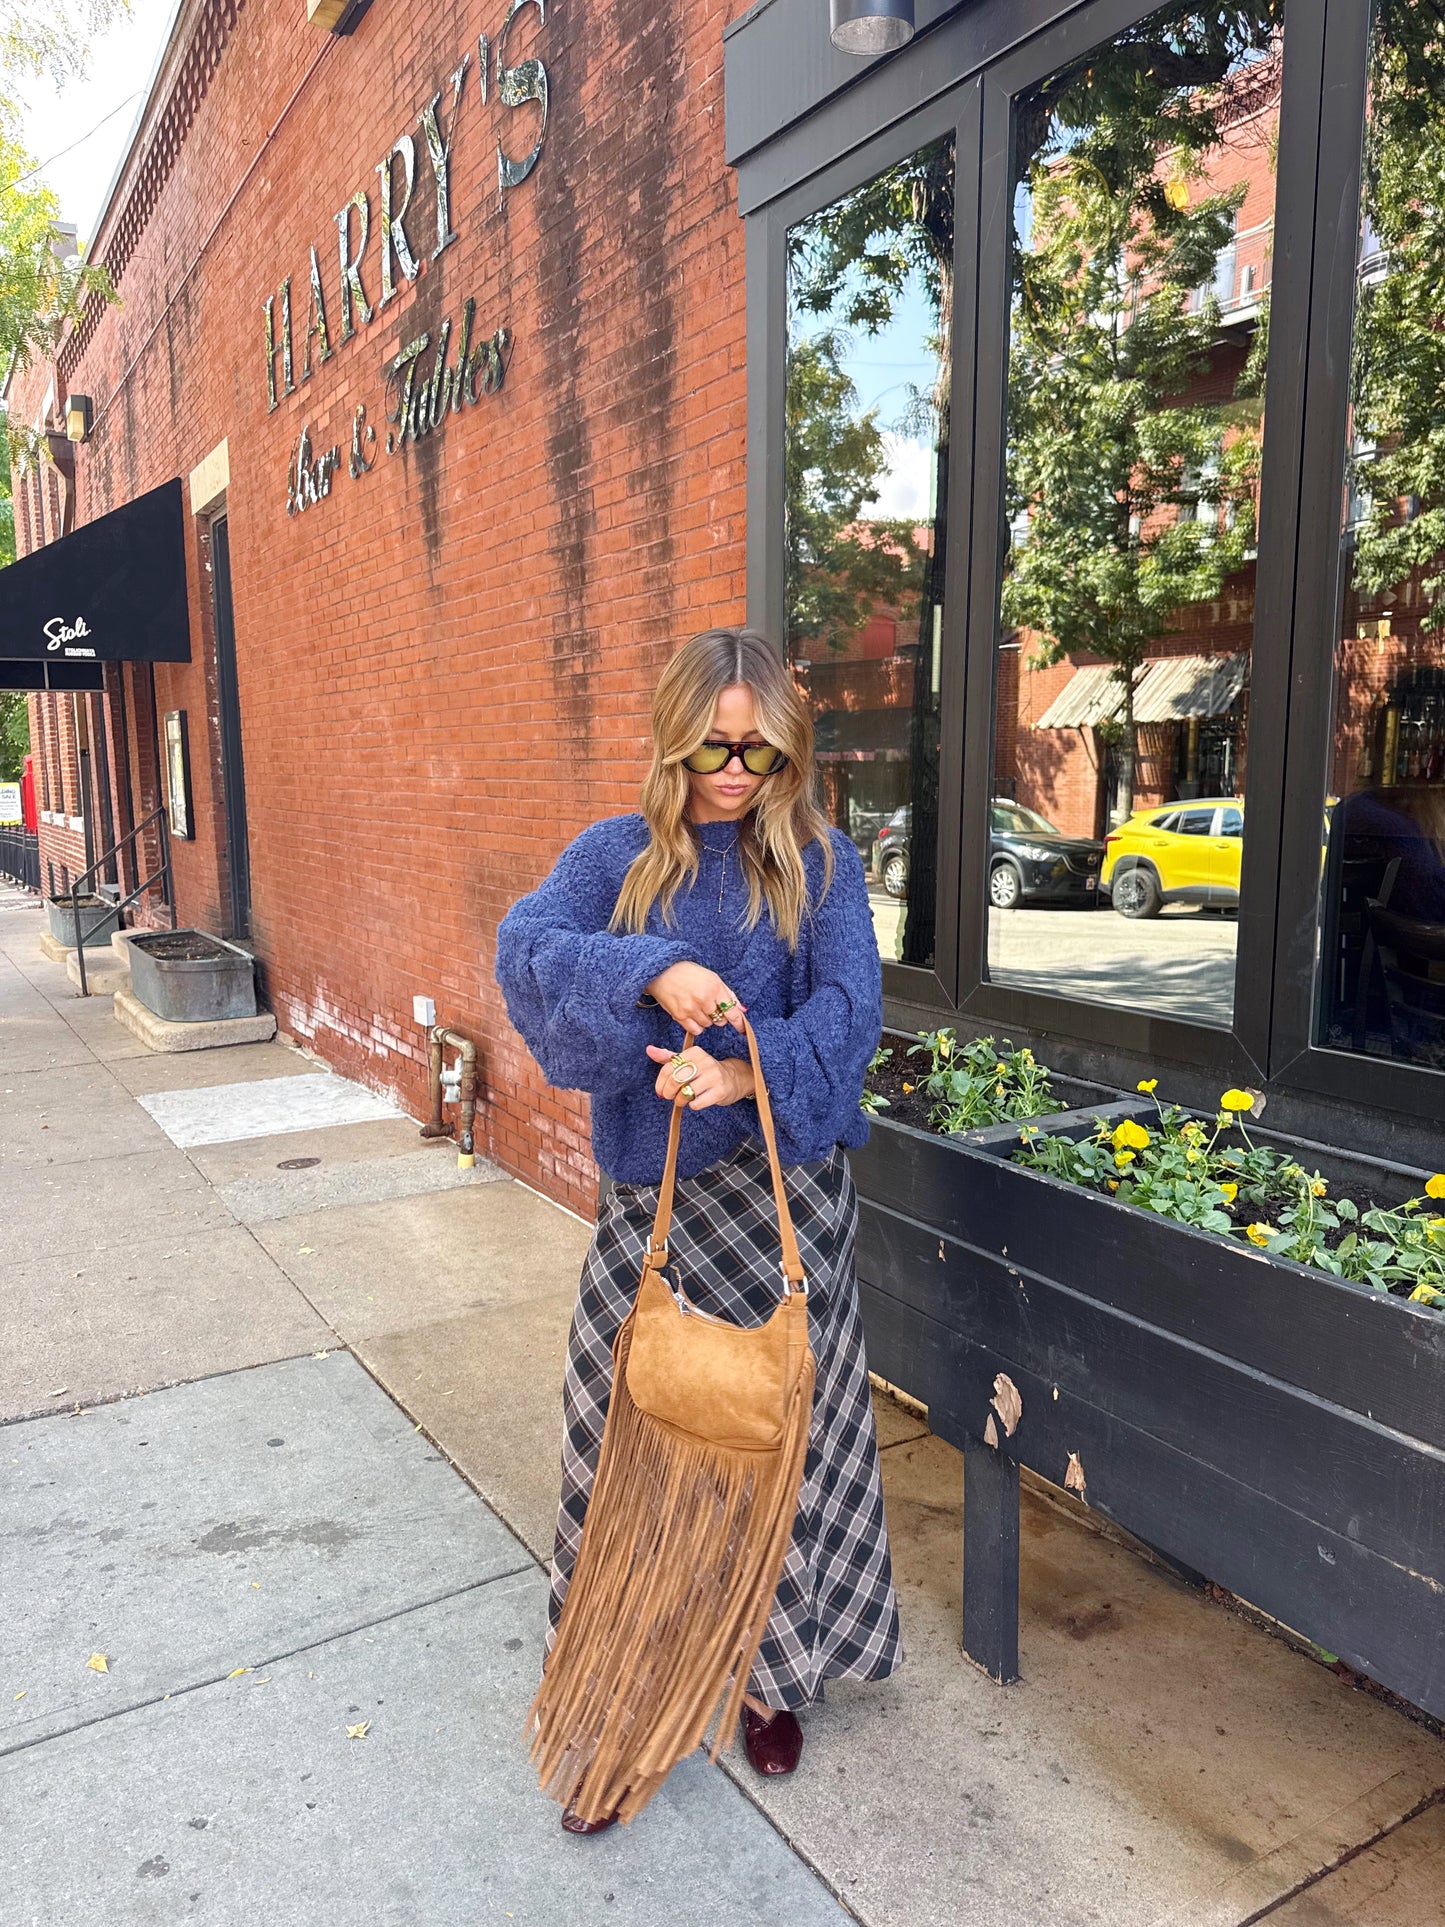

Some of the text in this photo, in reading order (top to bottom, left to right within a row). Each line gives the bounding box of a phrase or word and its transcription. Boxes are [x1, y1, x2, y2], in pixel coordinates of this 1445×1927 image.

[262, 0, 548, 413] HARRY'S
[286, 297, 516, 518] Bar & Tables
[43, 616, 91, 650] Stoli
